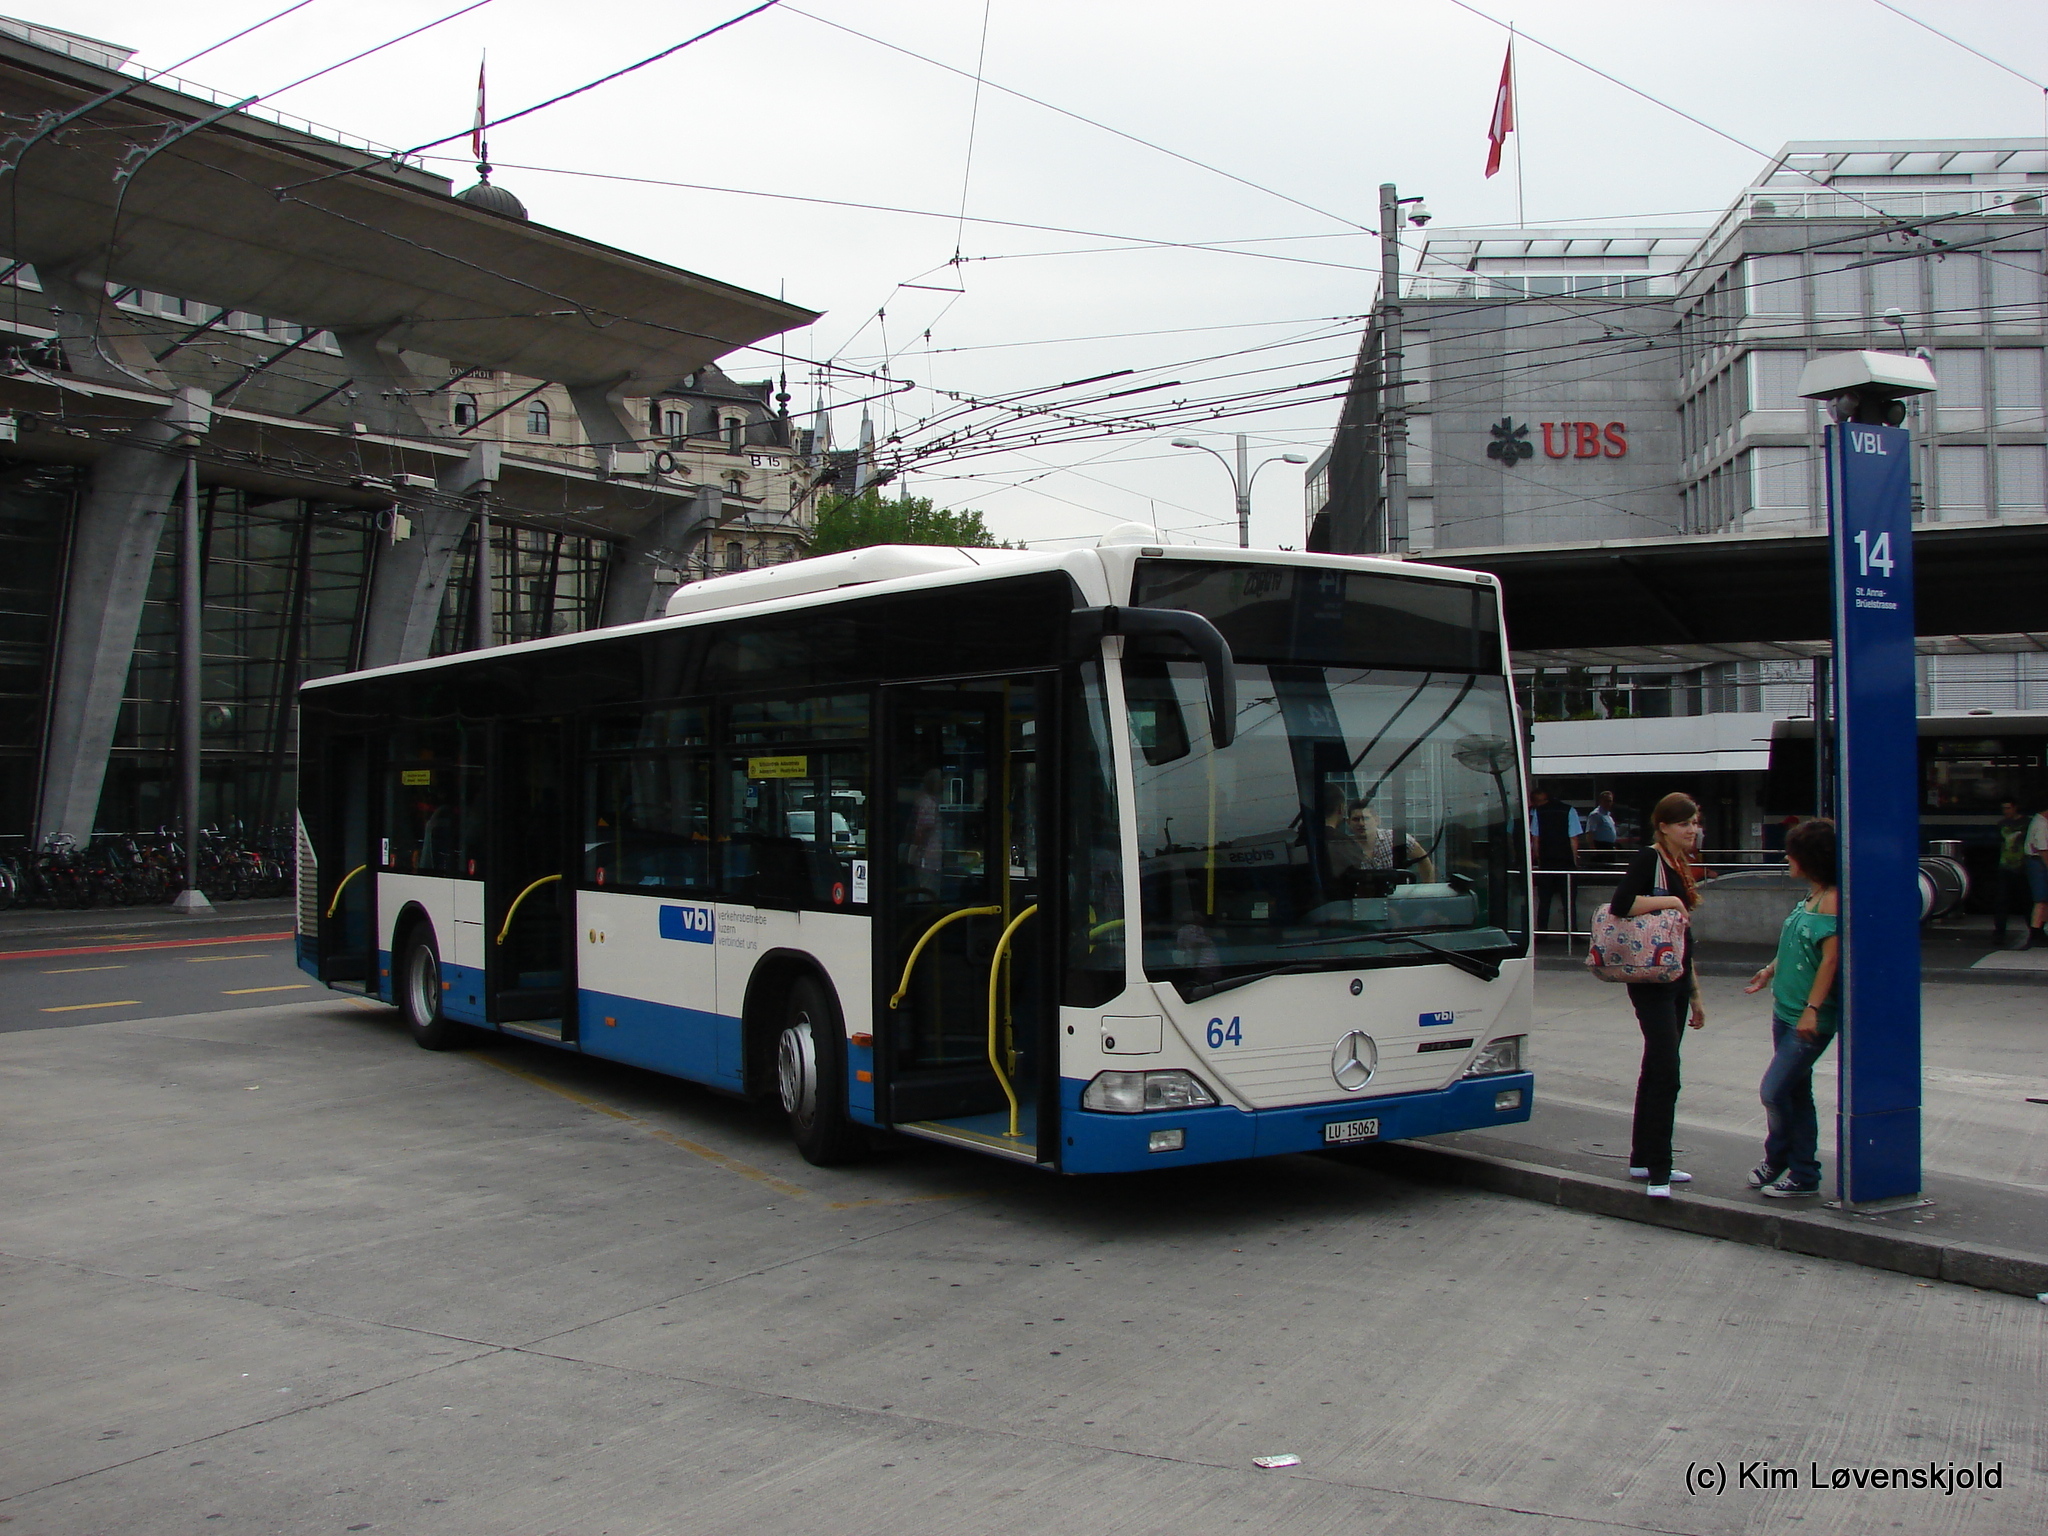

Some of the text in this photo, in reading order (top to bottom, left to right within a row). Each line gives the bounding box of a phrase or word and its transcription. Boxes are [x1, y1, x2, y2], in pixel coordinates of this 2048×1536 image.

[1540, 421, 1627, 459] UBS
[1850, 431, 1887, 455] VBL
[751, 455, 780, 467] B 15
[1854, 530, 1894, 577] 14
[1855, 586, 1887, 597] St. Anna-
[1855, 598, 1897, 610] Brüelstrasse
[682, 908, 713, 932] vbl
[718, 910, 767, 925] verkehrsbetriebe
[718, 923, 736, 934] luzern
[1434, 1010, 1453, 1021] vbl
[1206, 1016, 1242, 1049] 64
